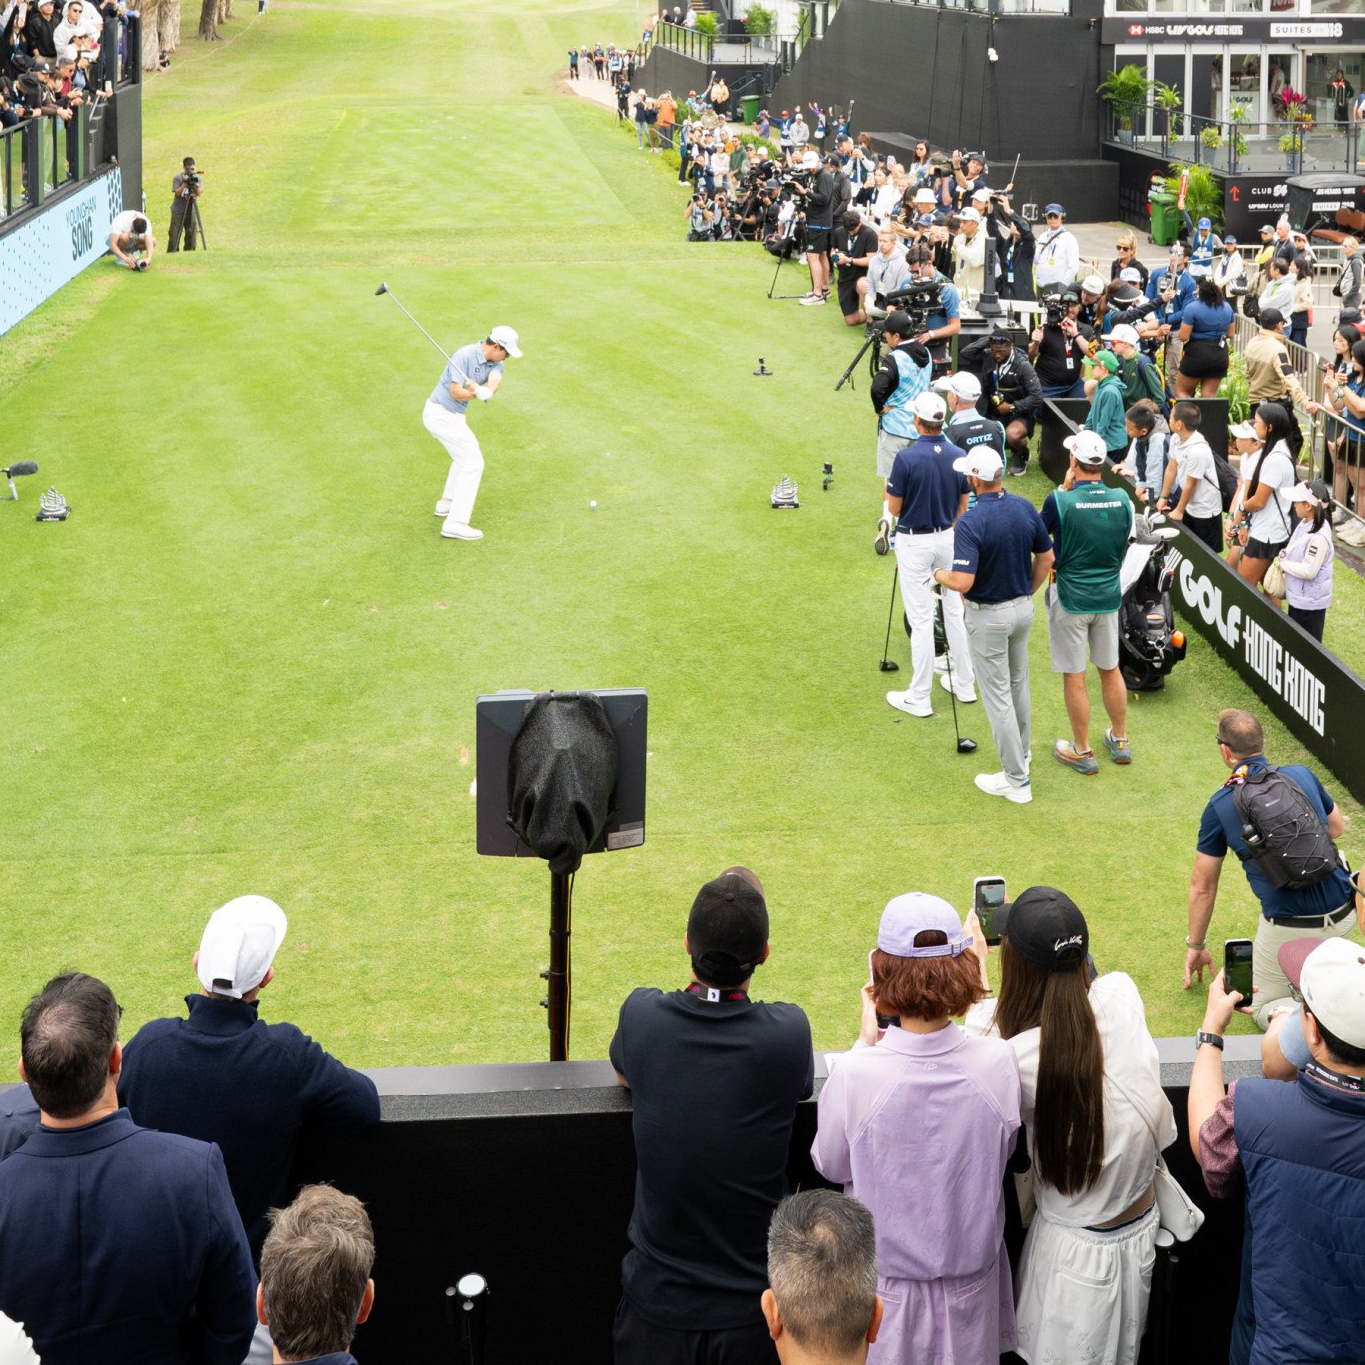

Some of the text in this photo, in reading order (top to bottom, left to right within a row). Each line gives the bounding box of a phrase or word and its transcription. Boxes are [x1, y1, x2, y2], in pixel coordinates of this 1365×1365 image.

[1145, 26, 1164, 34] HSBC
[1275, 26, 1312, 34] SUITES
[1251, 187, 1272, 195] CLUB
[72, 216, 93, 261] SONG
[966, 433, 993, 445] ORTIZ
[1075, 501, 1122, 509] BURMESTER
[1180, 559, 1326, 737] GOLF HONG KONG
